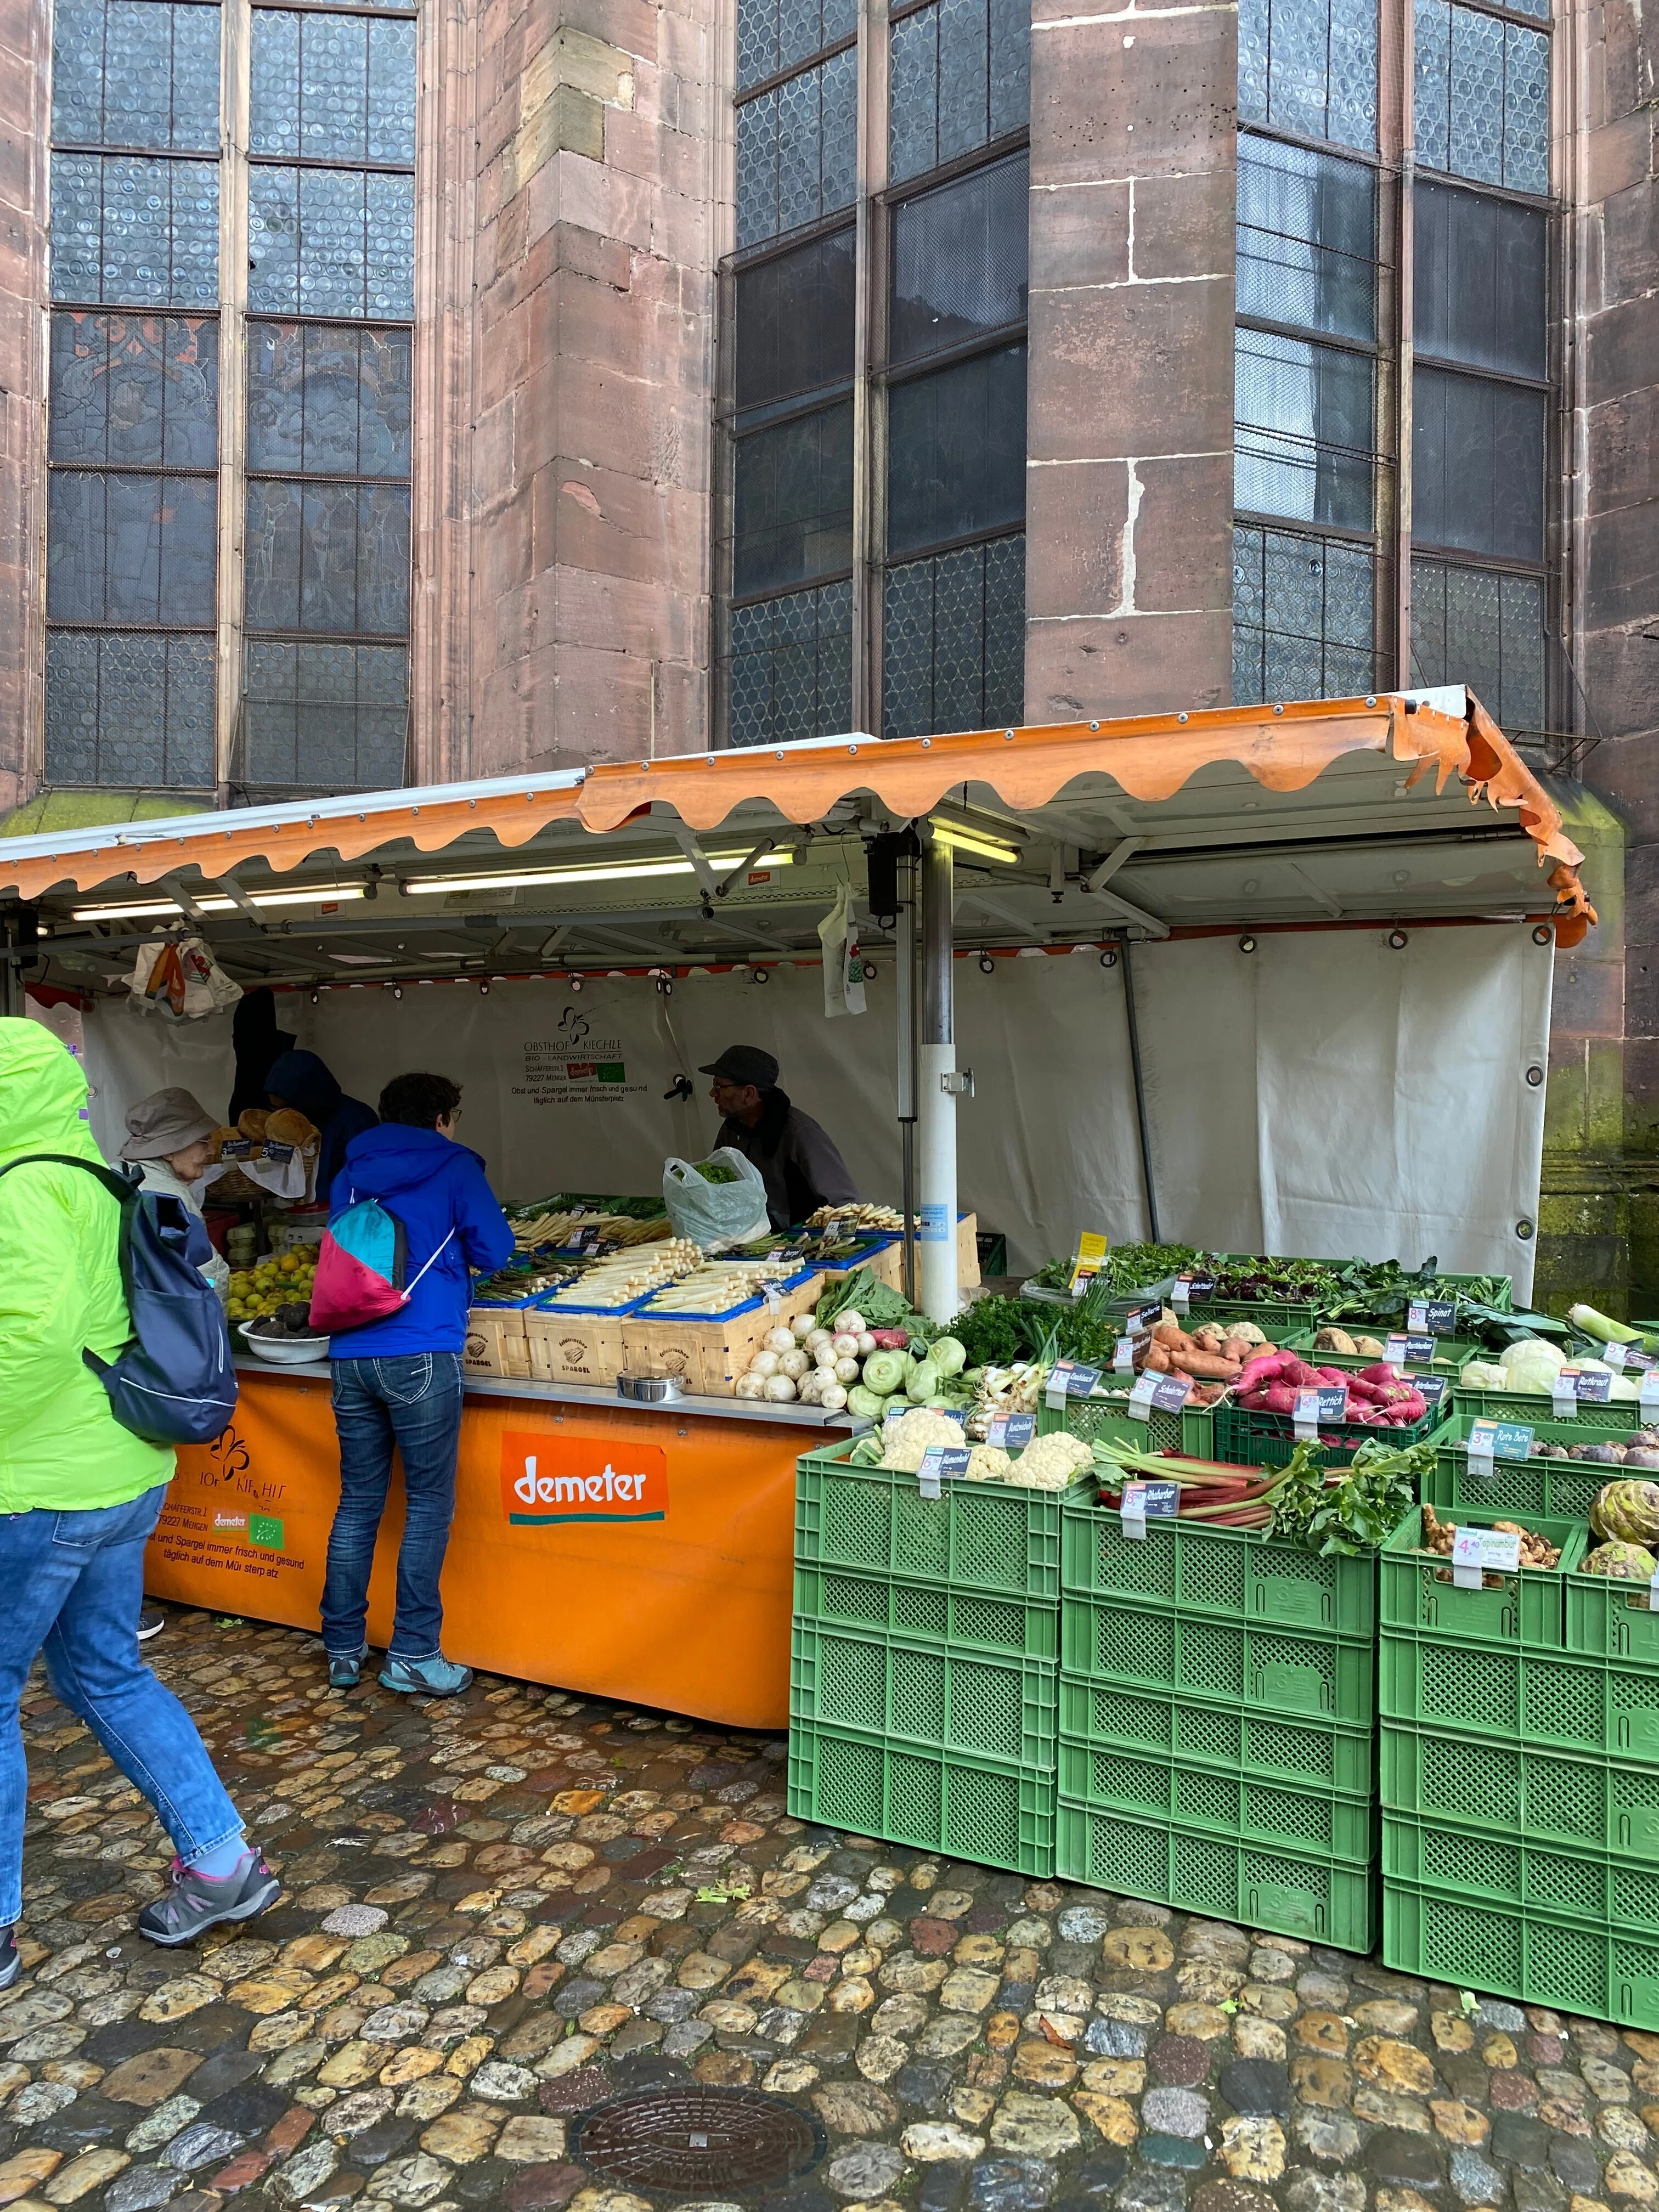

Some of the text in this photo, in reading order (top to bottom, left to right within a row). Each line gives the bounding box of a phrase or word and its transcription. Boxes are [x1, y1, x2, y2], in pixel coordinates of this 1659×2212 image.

[524, 1040, 622, 1051] OBSTHOF KIECHLE
[541, 1086, 568, 1095] Spargel
[620, 1085, 647, 1093] gesund
[533, 1096, 555, 1105] täglich
[1141, 1305, 1160, 1319] Sellerie
[1428, 1308, 1452, 1319] Spinat
[562, 1365, 590, 1373] SPARGEL
[1578, 1376, 1609, 1386] Rotkraut
[1158, 1384, 1186, 1397] Schalotten
[1319, 1394, 1343, 1407] Rettich
[1497, 1430, 1529, 1442] Rote Bete
[941, 1453, 970, 1465] Blumenkohl
[514, 1455, 646, 1504] demeter
[1146, 1488, 1175, 1500] Rhabarber
[182, 1518, 208, 1532] MENGEN
[214, 1513, 246, 1527] demeter
[157, 1534, 174, 1544] und
[176, 1535, 206, 1550] Spargel
[207, 1541, 234, 1554] immer
[235, 1545, 258, 1559] frisch
[259, 1553, 275, 1562] und
[276, 1556, 304, 1570] gesund
[163, 1548, 190, 1562] täglich
[191, 1555, 205, 1564] auf
[206, 1556, 223, 1568] dem
